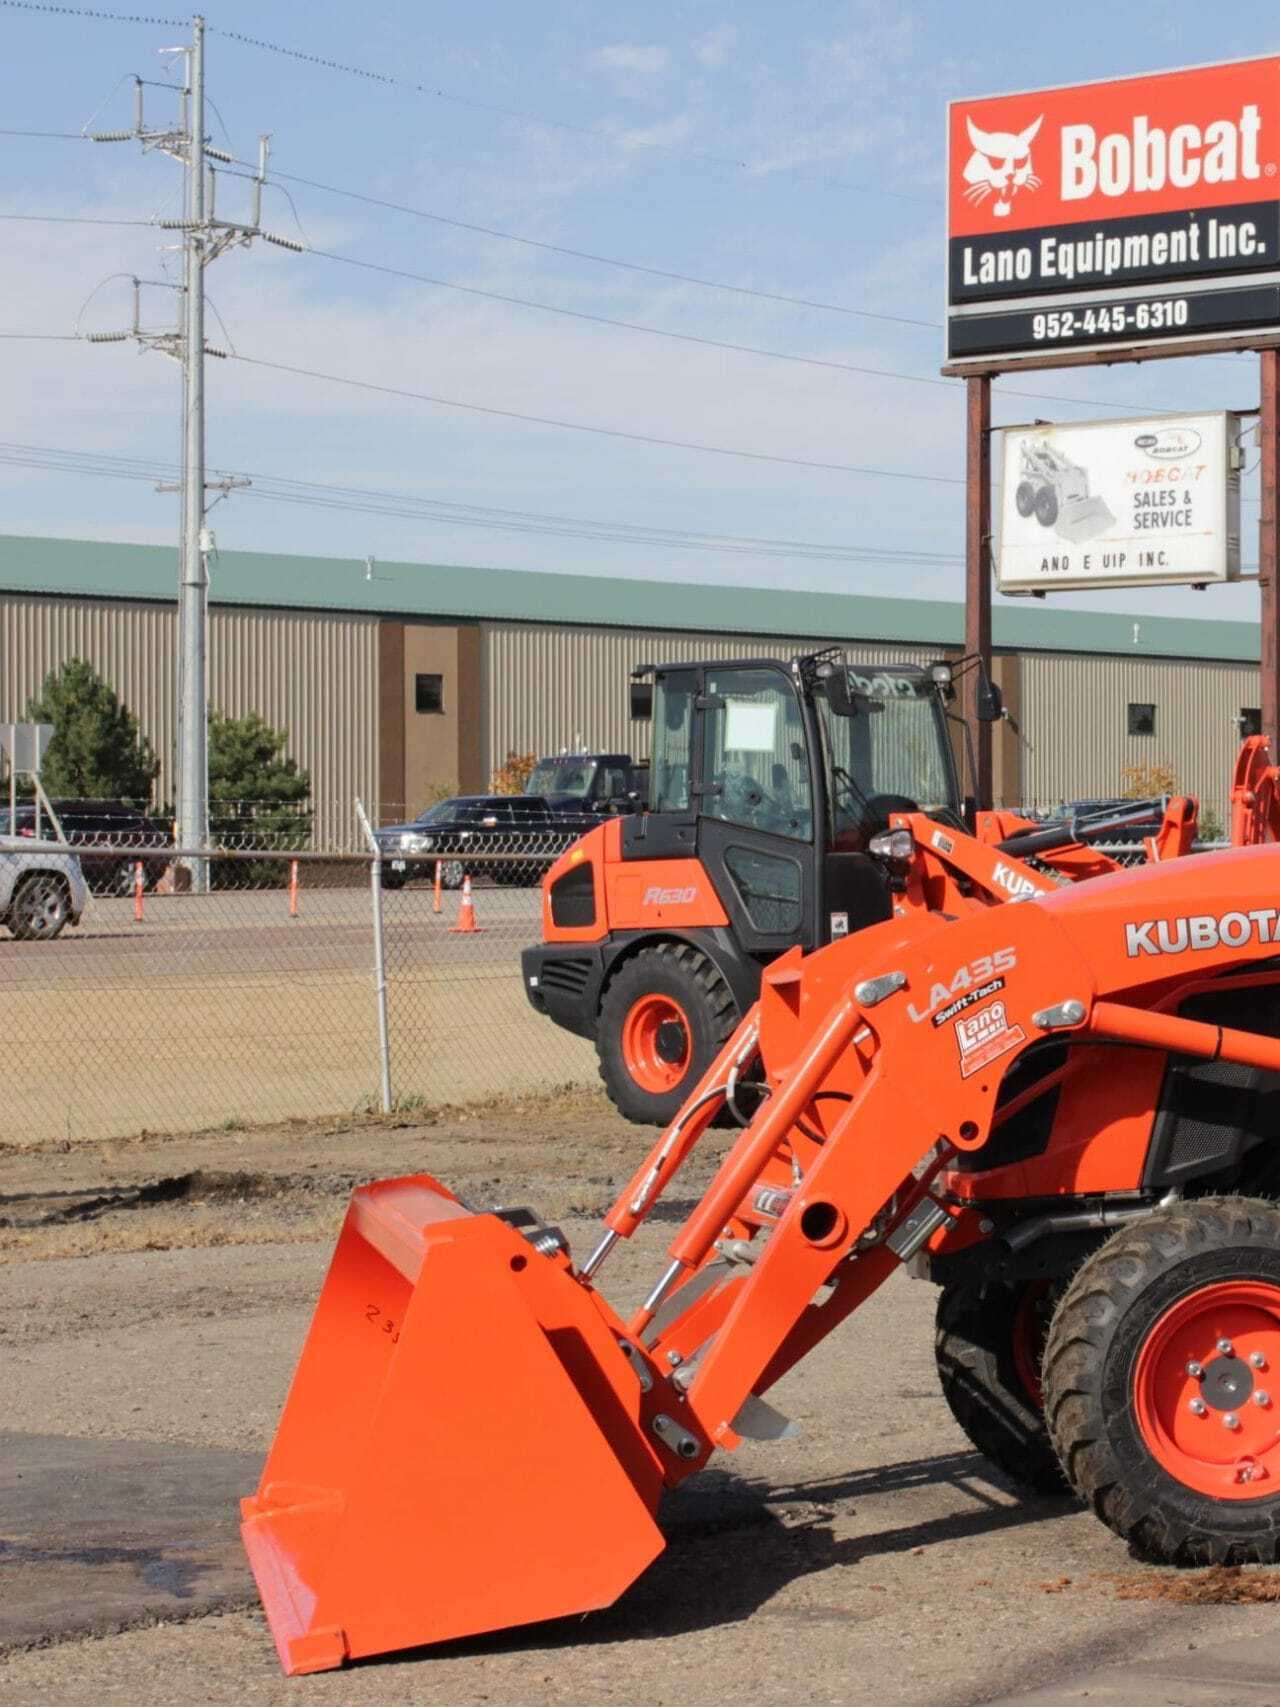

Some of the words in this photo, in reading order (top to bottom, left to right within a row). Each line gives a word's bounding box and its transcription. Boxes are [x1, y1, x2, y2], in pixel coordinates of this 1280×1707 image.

[1060, 105, 1261, 201] Bobcat
[963, 247, 1031, 285] Lano
[1040, 222, 1199, 280] Equipment
[1208, 219, 1266, 259] Inc.
[1032, 300, 1188, 339] 952-445-6310
[1133, 490, 1176, 508] SALES
[1183, 490, 1192, 505] &
[1133, 509, 1192, 529] SERVICE
[1139, 550, 1169, 567] INC.
[906, 946, 1017, 1024] LA435
